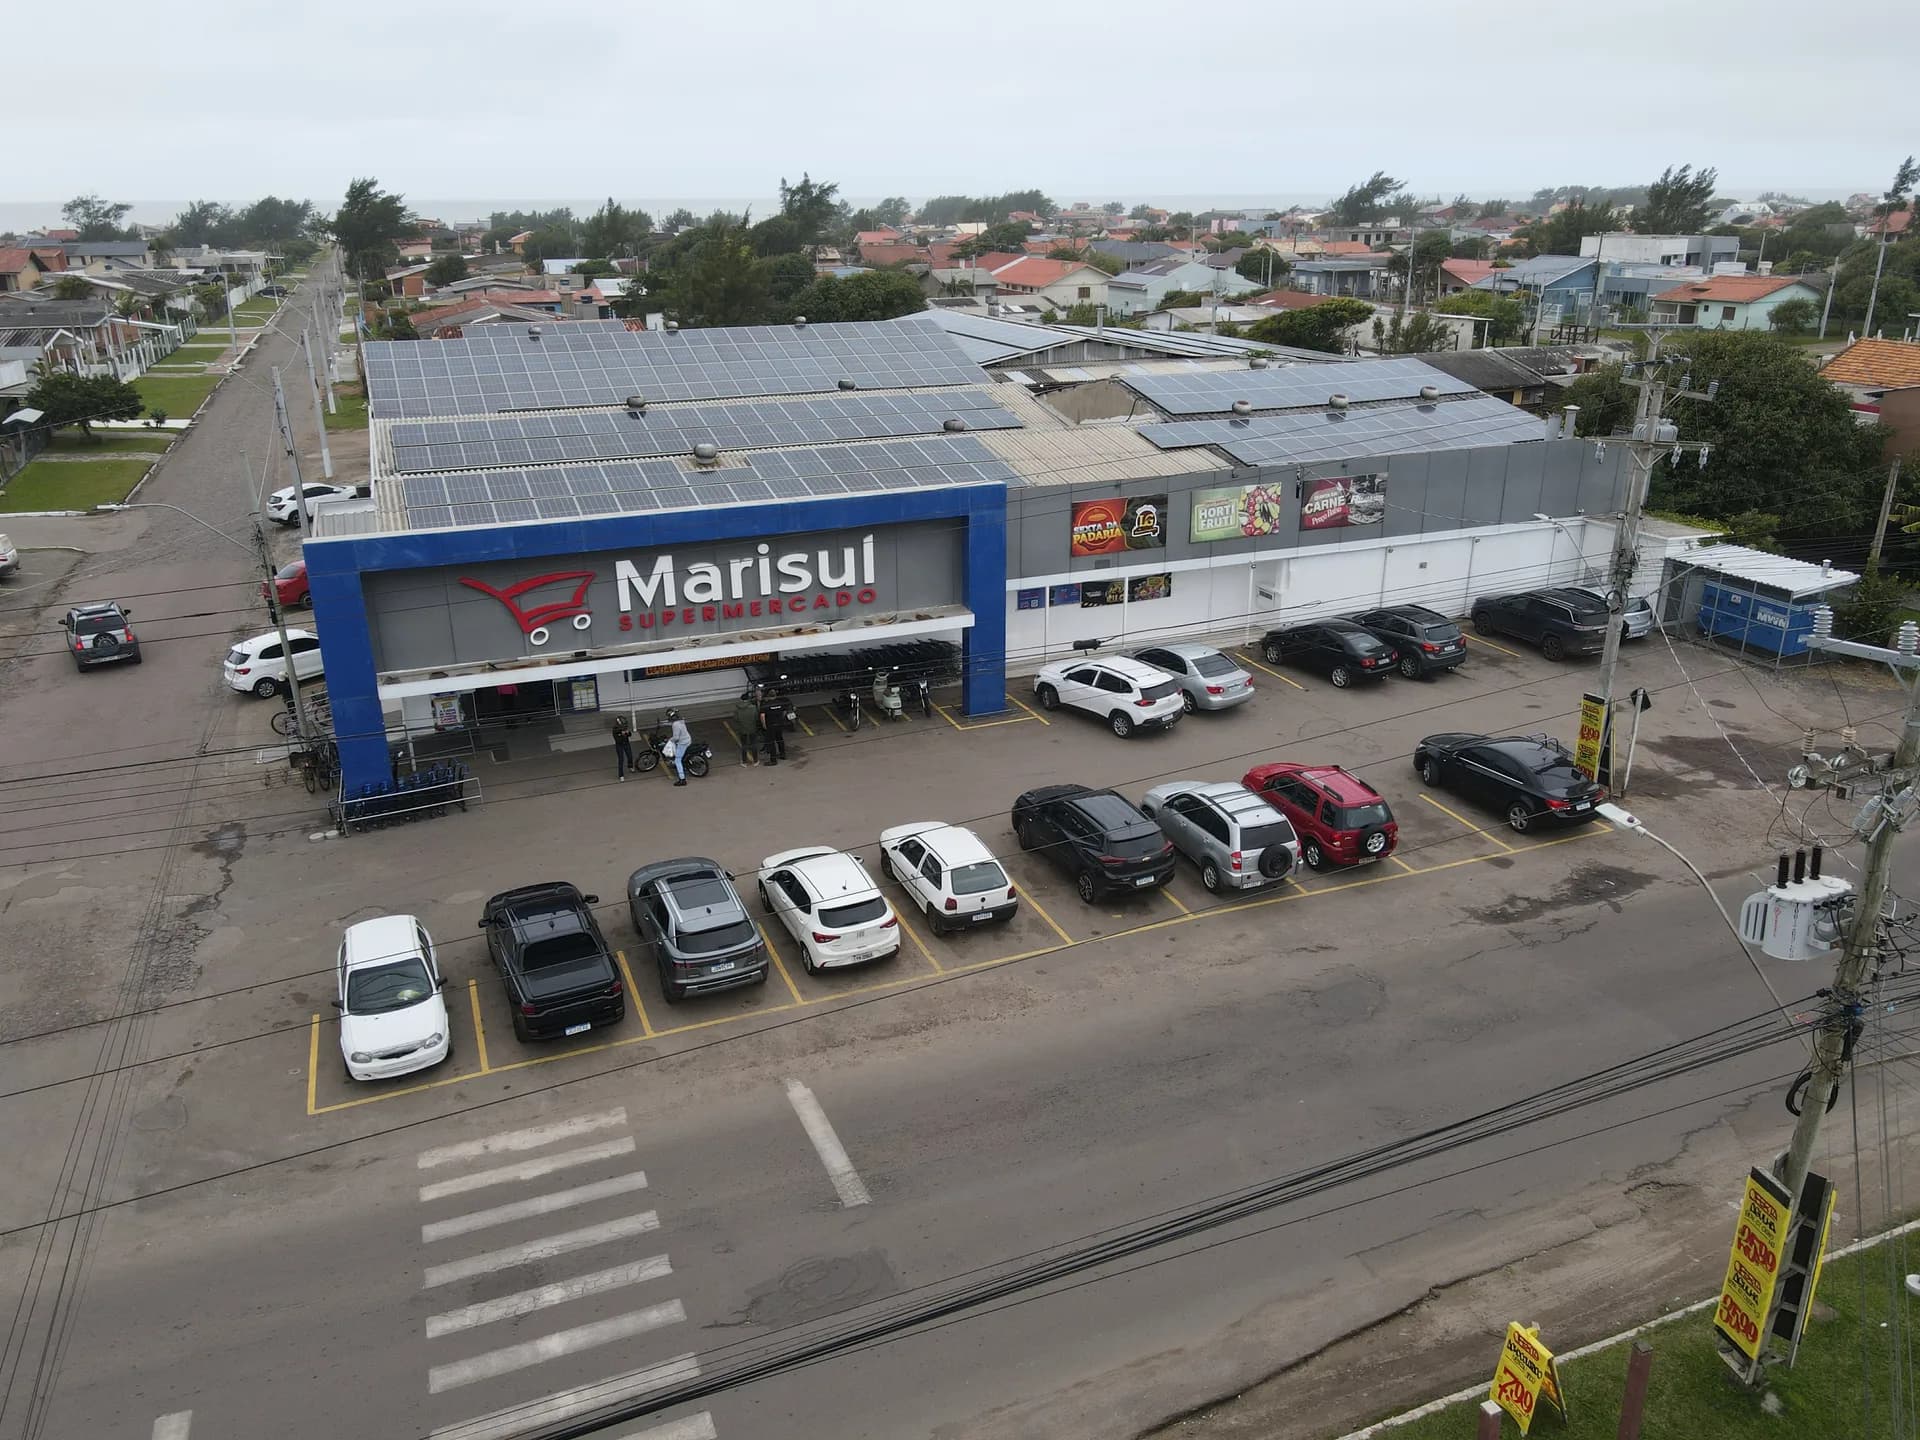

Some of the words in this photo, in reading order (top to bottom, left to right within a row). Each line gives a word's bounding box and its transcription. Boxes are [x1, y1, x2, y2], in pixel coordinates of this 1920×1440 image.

[1199, 504, 1235, 519] HORTI
[1305, 495, 1346, 514] CARNE
[1139, 513, 1155, 527] LG
[1200, 515, 1233, 529] FRUTI
[1072, 528, 1122, 544] PADARIA
[1073, 523, 1103, 534] SEXTA
[615, 533, 876, 612] Marisul
[618, 587, 878, 632] SUPERMERCADO
